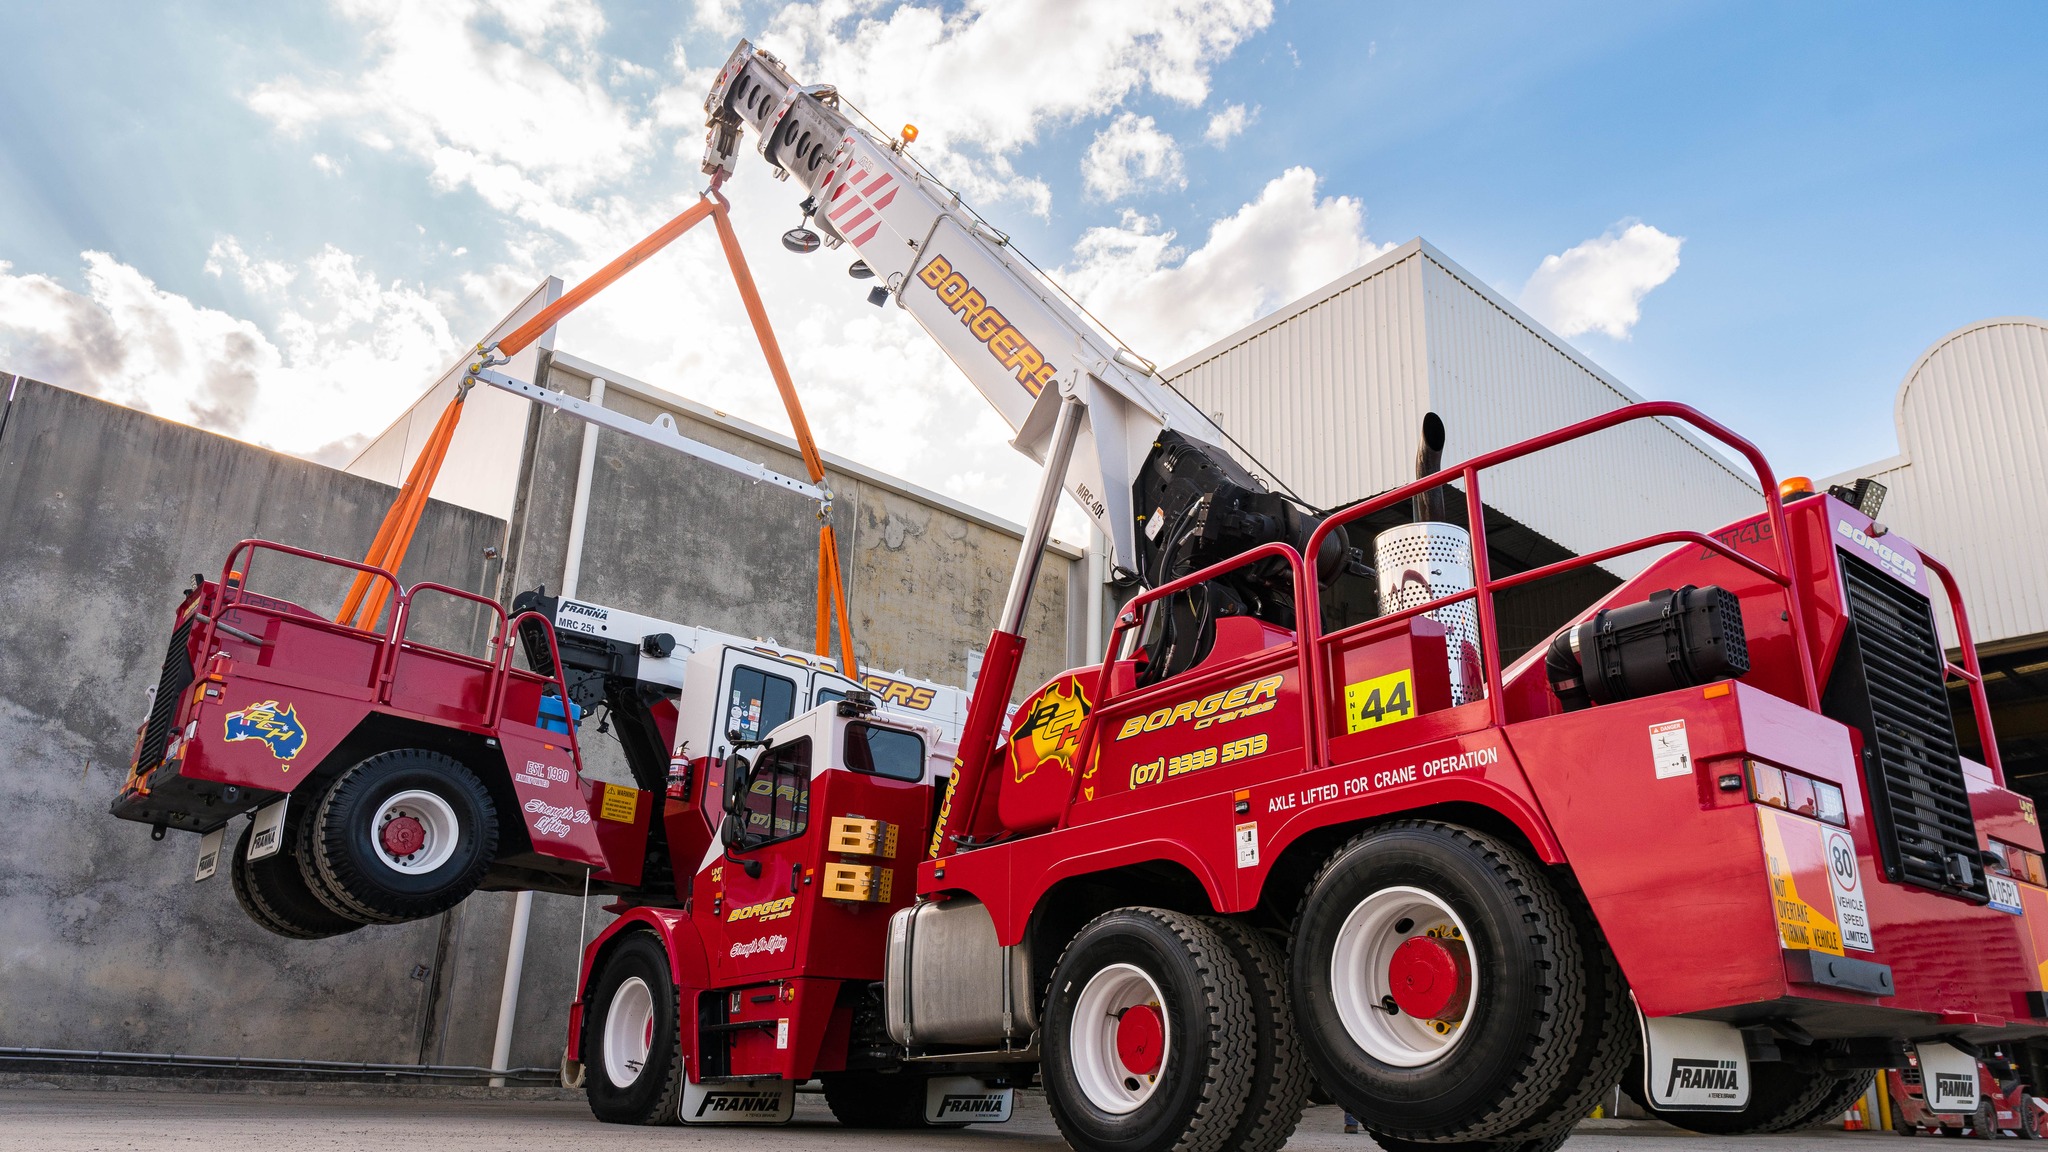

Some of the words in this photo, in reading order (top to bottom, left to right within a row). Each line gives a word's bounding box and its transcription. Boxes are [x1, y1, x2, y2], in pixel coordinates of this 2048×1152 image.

[916, 253, 1057, 400] BORGERS
[1075, 482, 1094, 506] MRC
[1091, 500, 1104, 519] 40t
[1837, 519, 1917, 577] BORGER
[559, 600, 608, 620] FRANNA
[558, 617, 578, 630] MRC
[580, 622, 595, 634] 25t
[1115, 674, 1284, 742] BORGER
[1193, 699, 1278, 731] cranes
[1348, 690, 1357, 732] UNIT
[1360, 681, 1411, 723] 44
[1660, 722, 1682, 732] DANGER
[526, 761, 545, 778] EST.
[547, 765, 570, 784] 1980
[1129, 756, 1165, 790] (07)
[1167, 746, 1218, 777] 3333
[1220, 733, 1269, 764] 5513
[1268, 793, 1296, 813] AXLE
[1300, 783, 1339, 806] LIFTED
[1344, 776, 1369, 796] FOR
[1374, 765, 1417, 789] CRANE
[1422, 747, 1499, 778] OPERATION
[251, 826, 277, 856] FRANNA
[1832, 846, 1853, 879] 80
[1774, 878, 1787, 898] NOT
[726, 896, 796, 923] BORGER
[1778, 899, 1810, 924] OVERTAKE
[1837, 896, 1864, 912] VEHICLE
[1843, 912, 1864, 928] SPEED
[1812, 927, 1838, 951] VEHICLE
[1844, 929, 1869, 944] LIMITED
[1665, 1057, 1739, 1098] FRANNA
[1935, 1072, 1974, 1104] FRANNA
[695, 1090, 782, 1117] FRANNA
[936, 1094, 1004, 1118] FRANNA
